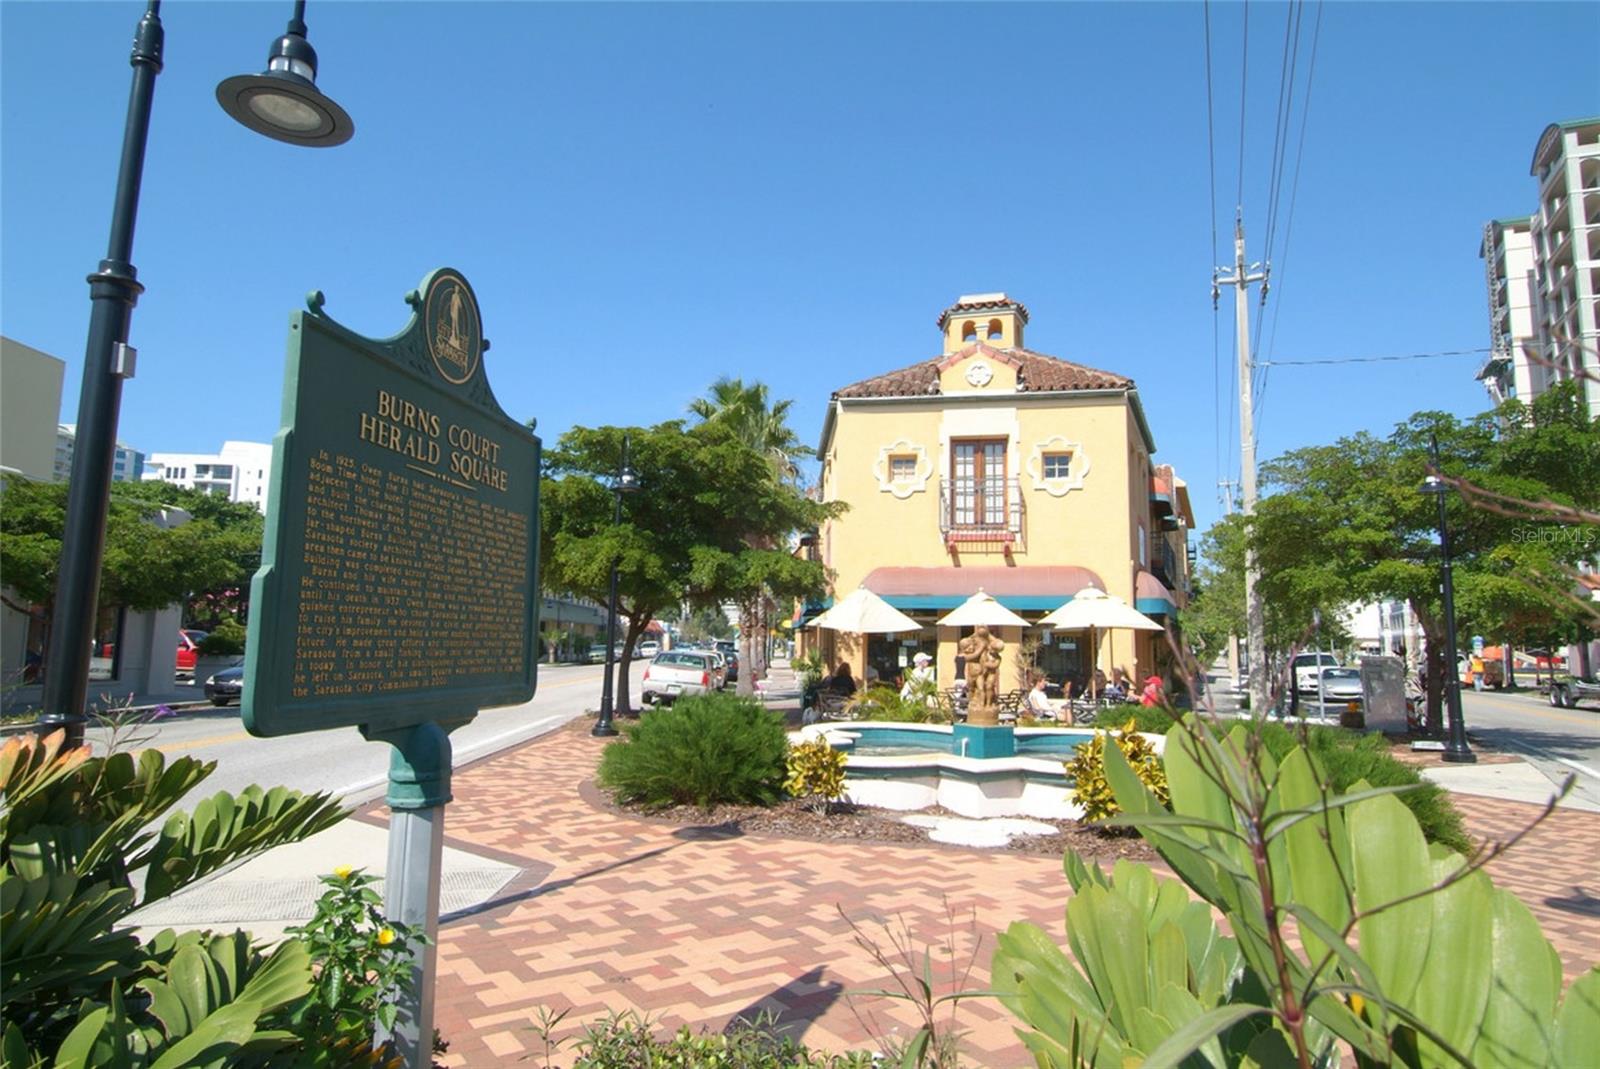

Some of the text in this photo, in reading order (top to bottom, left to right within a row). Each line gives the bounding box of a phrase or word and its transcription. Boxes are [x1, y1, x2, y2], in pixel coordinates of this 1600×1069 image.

[360, 413, 508, 491] HERALD SQUARE
[378, 390, 500, 463] BURNS COURT
[310, 458, 333, 473] Boom
[338, 467, 356, 480] Time
